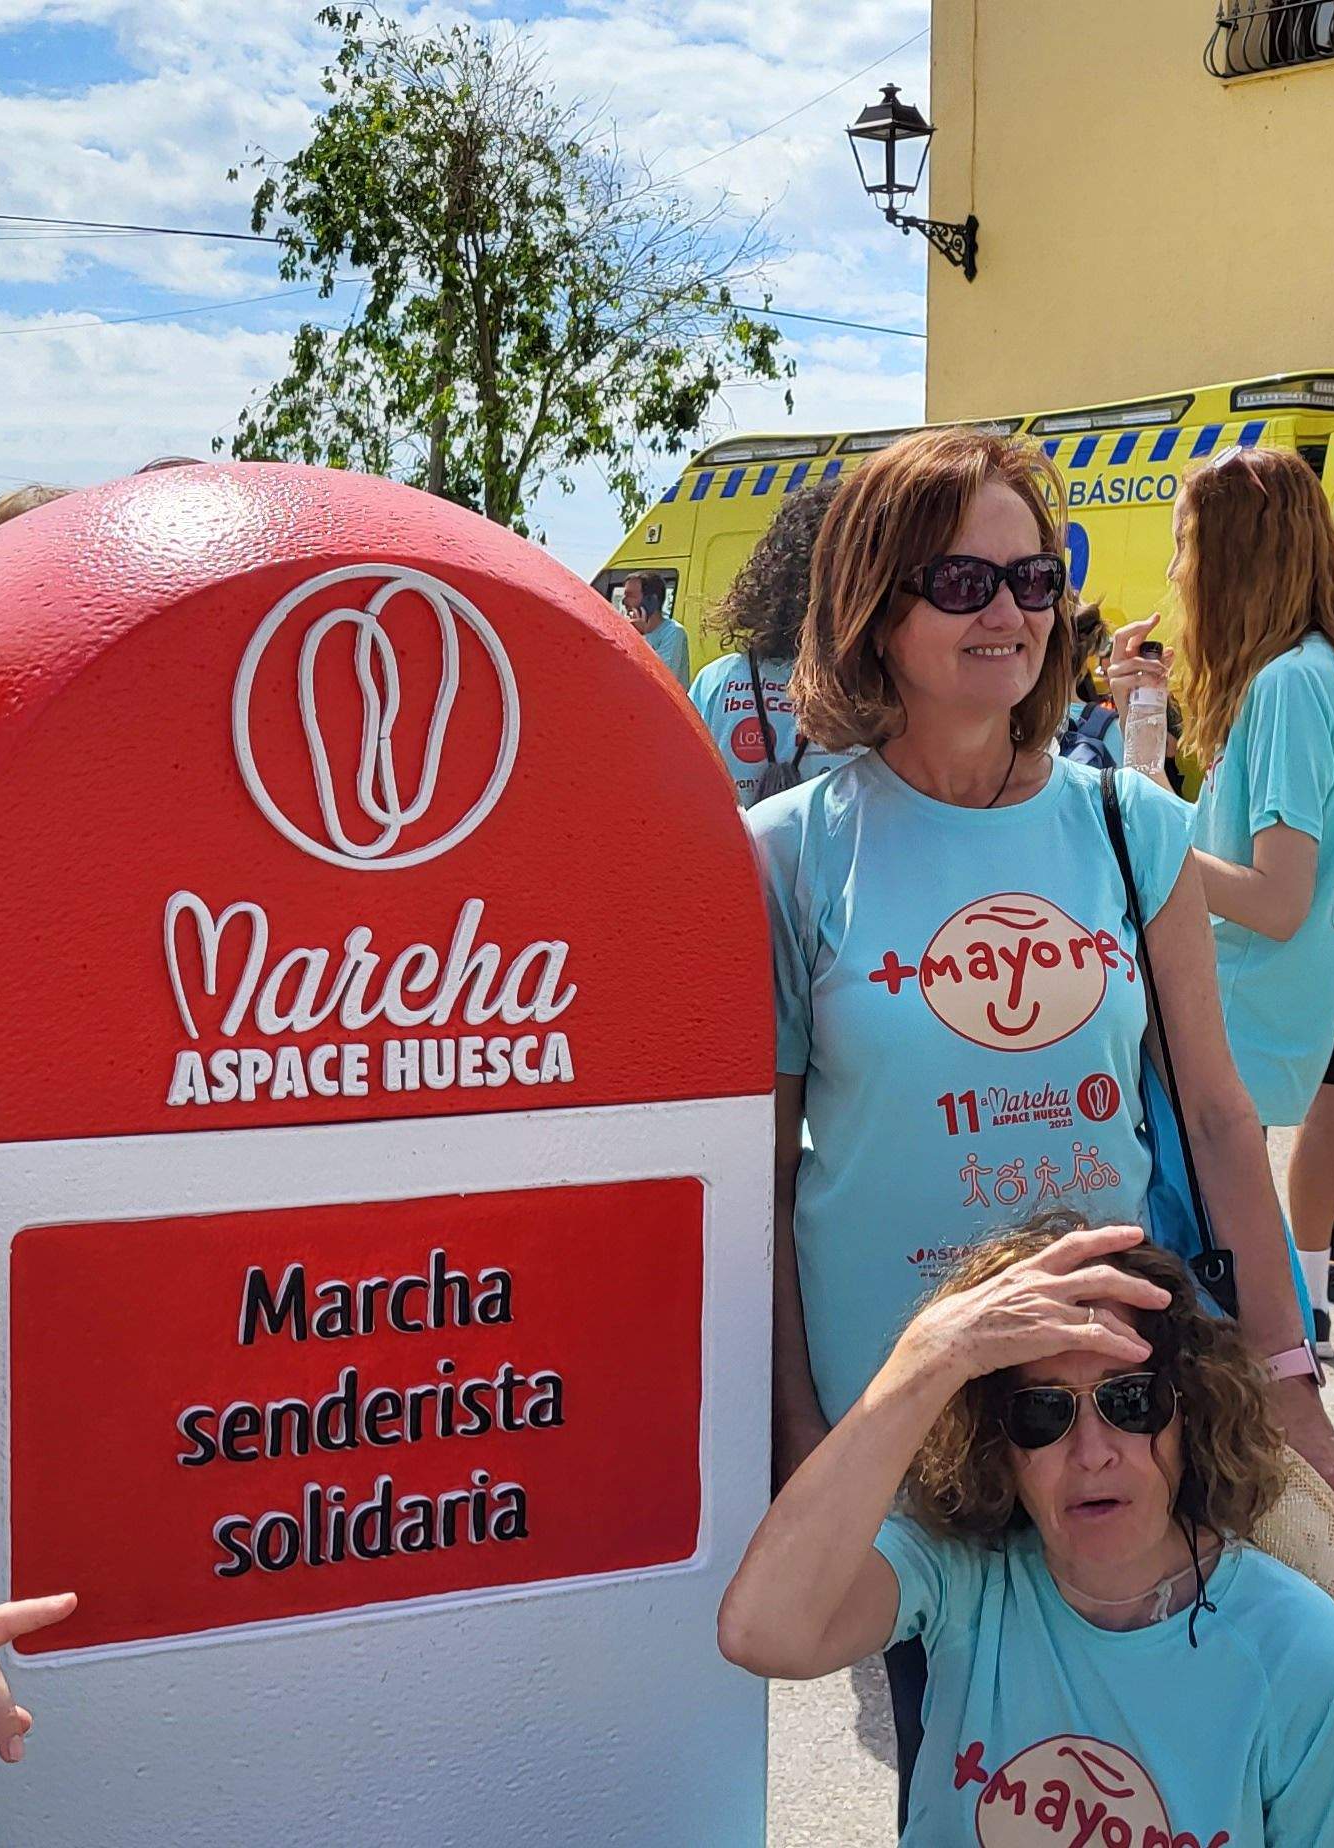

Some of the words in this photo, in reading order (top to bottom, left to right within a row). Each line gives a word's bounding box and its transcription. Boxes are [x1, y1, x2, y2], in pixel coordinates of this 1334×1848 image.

[1068, 473, 1178, 507] BÁSICO
[163, 890, 578, 1040] Marcha
[868, 929, 1136, 1010] +mayores
[167, 1042, 369, 1106] ASPACE
[383, 1032, 575, 1094] HUESCA
[987, 1081, 1072, 1113] Marcha
[992, 1111, 1031, 1126] ASPACE
[1033, 1107, 1073, 1121] HUESCA
[1048, 1119, 1074, 1129] 2023
[238, 1247, 514, 1346] Marcha
[177, 1359, 566, 1467] senderista
[213, 1469, 529, 1579] solidaria
